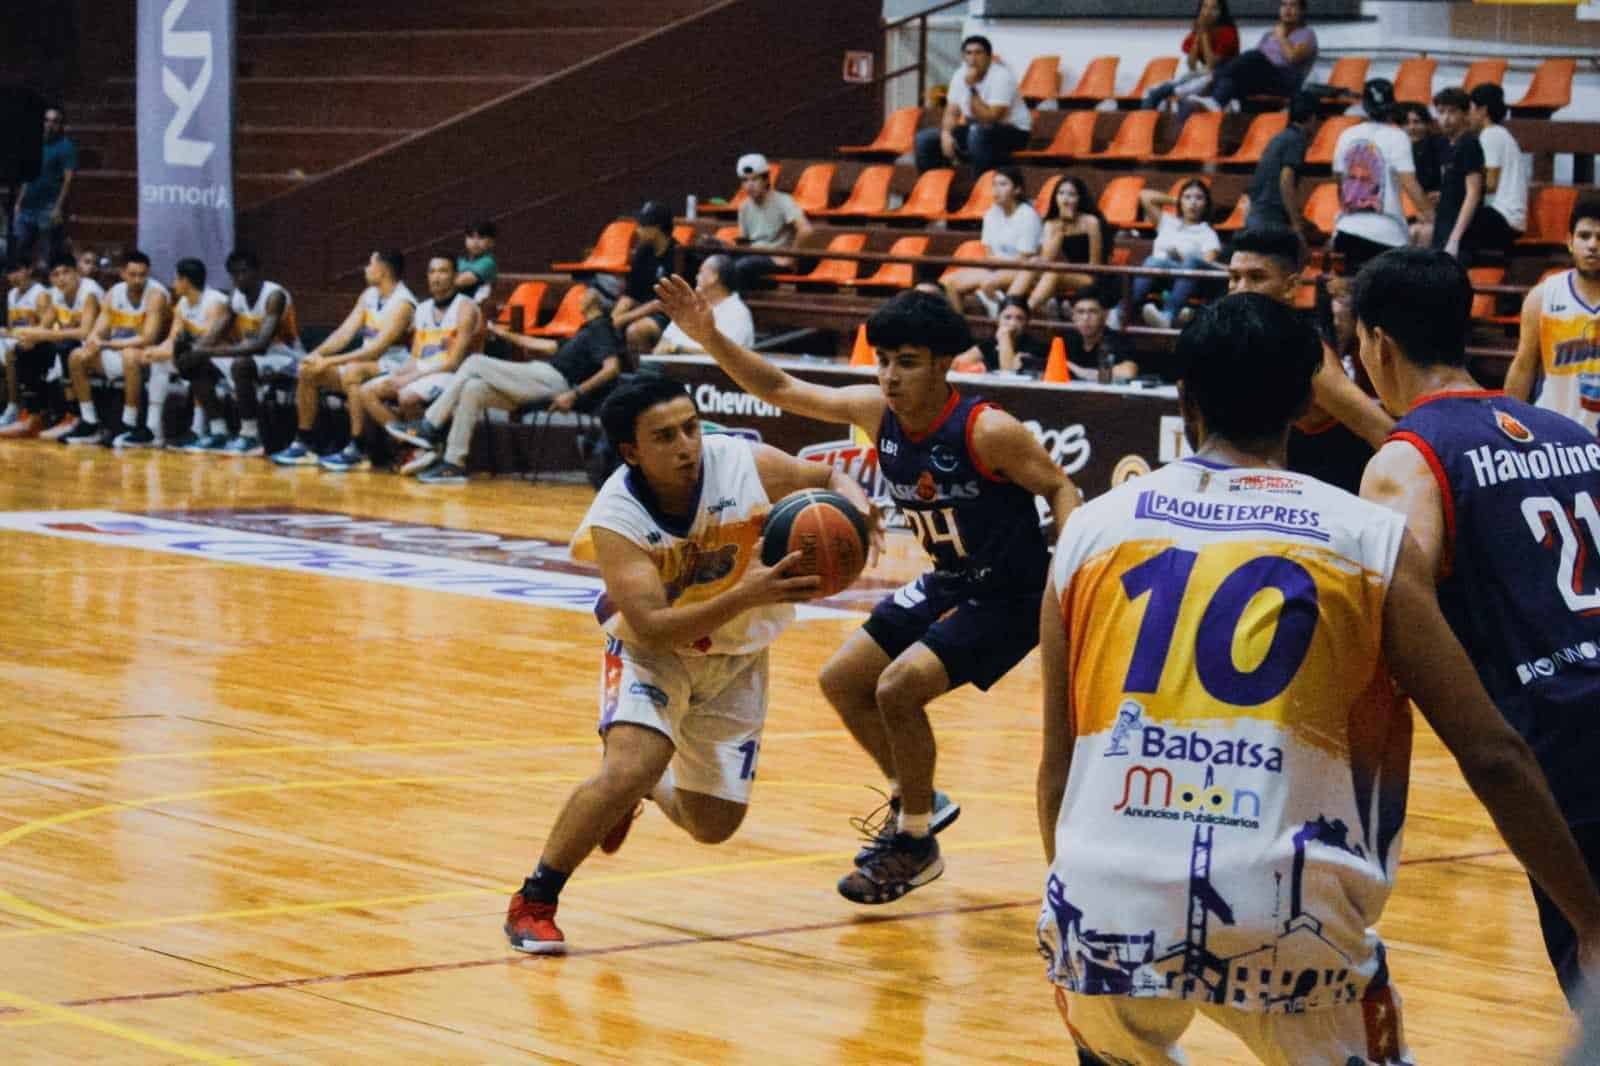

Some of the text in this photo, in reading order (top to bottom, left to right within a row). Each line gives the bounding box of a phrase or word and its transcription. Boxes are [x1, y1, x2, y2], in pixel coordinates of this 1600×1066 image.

[696, 383, 783, 418] Chevron
[1464, 440, 1600, 487] Havoline
[1155, 493, 1320, 528] PAQUETEXPRESS
[1120, 546, 1319, 707] 10
[1141, 726, 1284, 774] Babatsa
[1123, 806, 1181, 821] Anuncios
